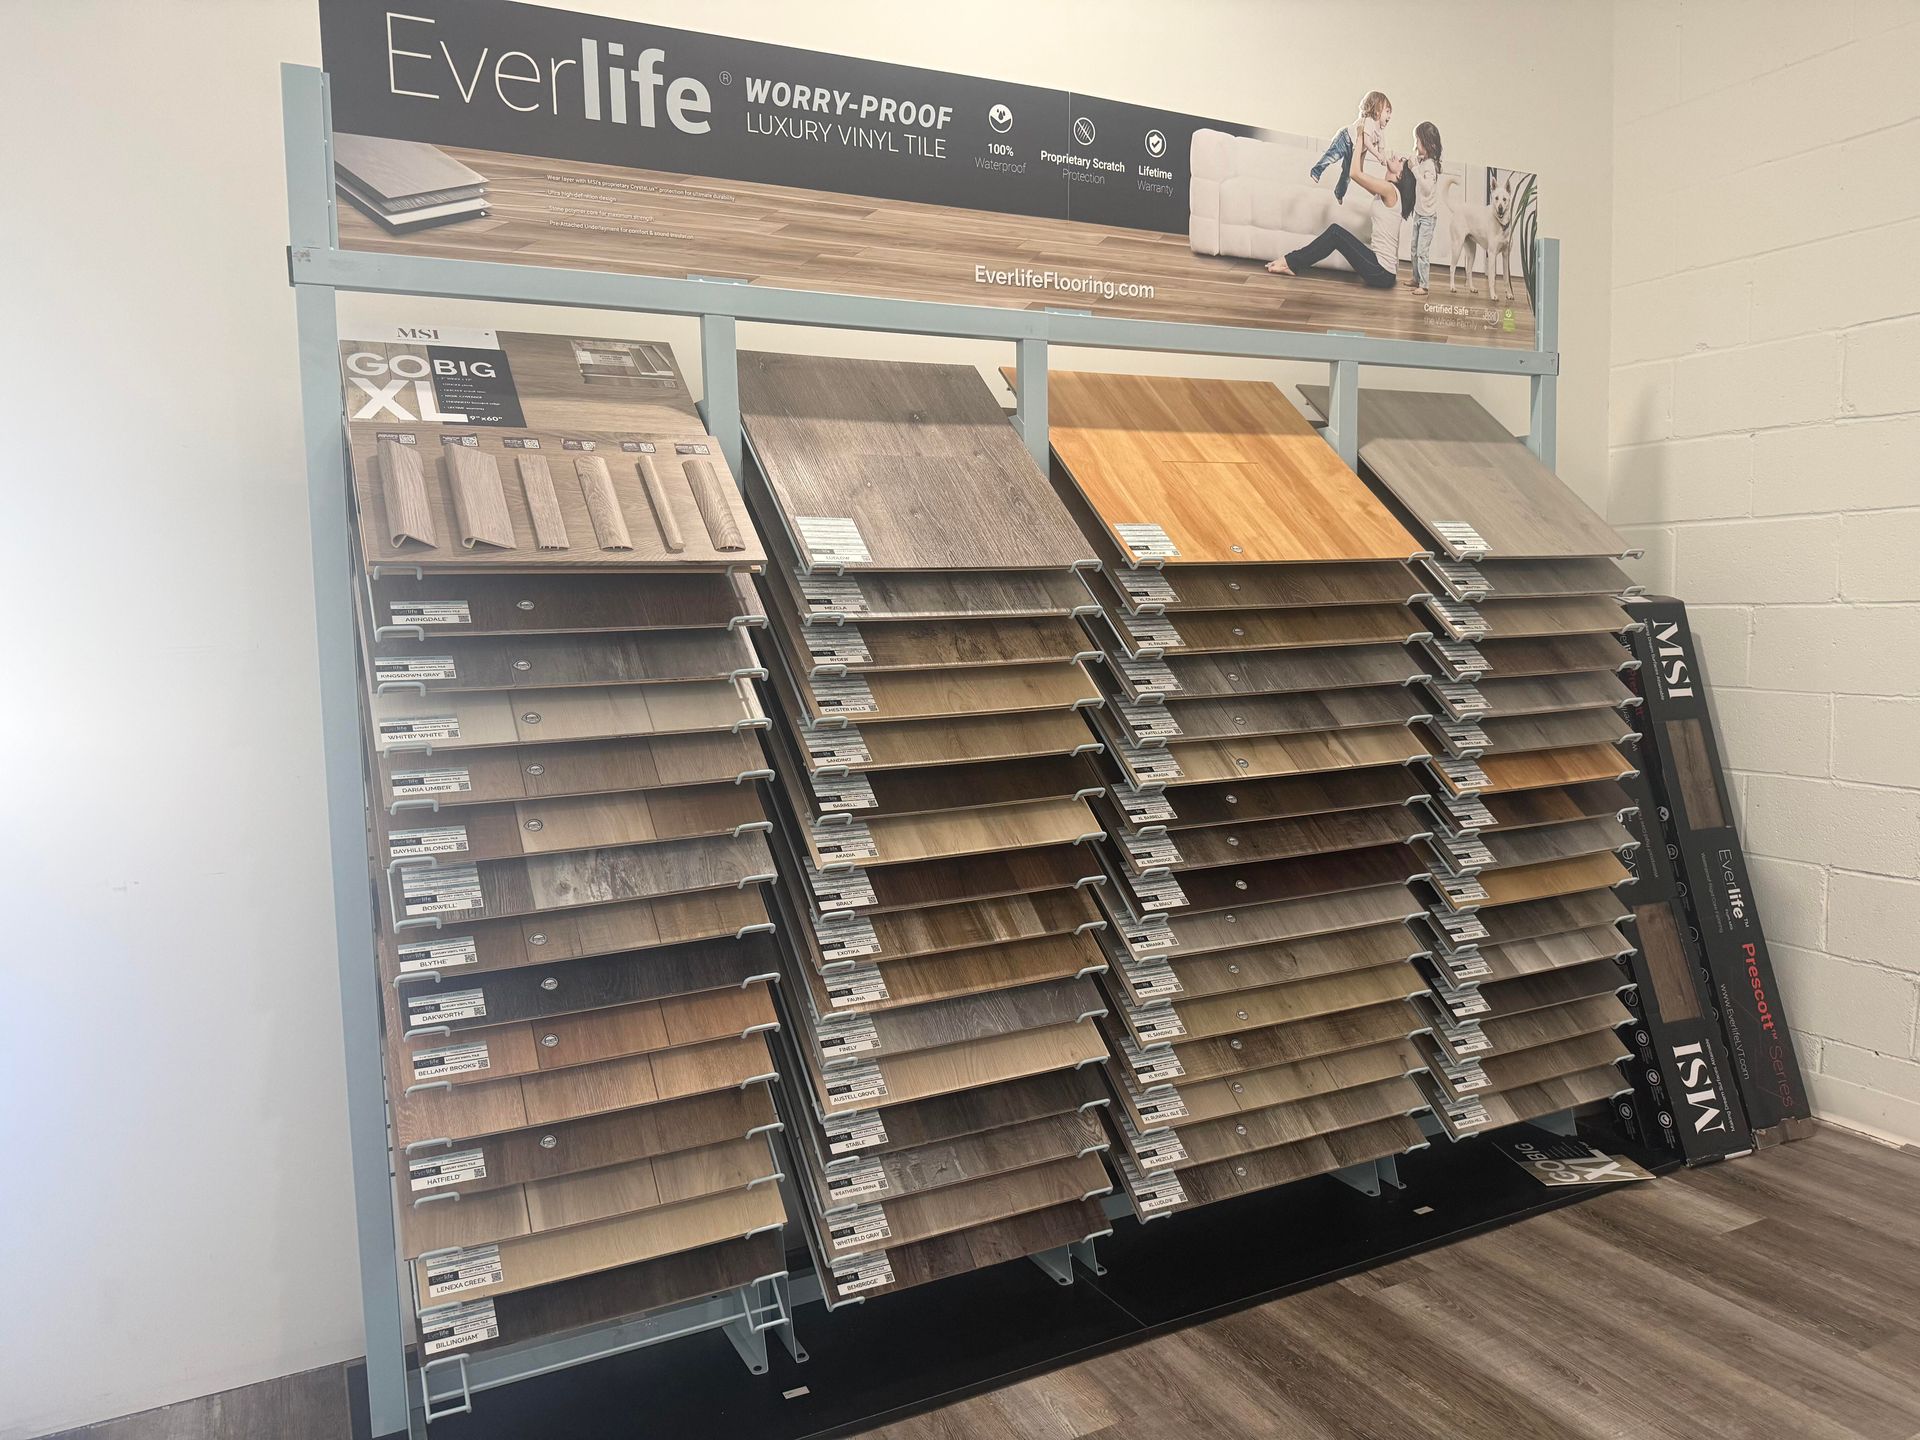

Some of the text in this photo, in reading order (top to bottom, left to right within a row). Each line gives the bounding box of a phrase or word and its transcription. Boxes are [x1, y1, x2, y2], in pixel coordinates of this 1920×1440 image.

[386, 12, 711, 134] Everlife
[745, 76, 953, 130] WORRY-PROOF
[746, 112, 947, 159] LUXURY VINYL TILE
[987, 142, 1014, 157] 100%
[974, 157, 1026, 175] Waterproof
[1040, 150, 1125, 173] Proprietary Scratch
[1062, 168, 1105, 185] Protection
[1138, 165, 1173, 181] Lifetime
[1137, 180, 1174, 196] Warranty
[974, 264, 1155, 299] EverlifeFlooring.com
[1424, 303, 1469, 316] Certified Safe
[397, 327, 440, 340] MSI
[346, 352, 497, 378] GO BIG
[348, 376, 469, 423] XL
[1651, 618, 1694, 700] MSI
[1718, 850, 1744, 918] Everlife
[422, 904, 457, 912] BOSWELL
[420, 960, 448, 968] BLYTHE
[1720, 984, 1750, 1080] www.EverlifeLVT.com
[1742, 942, 1775, 1031] Prescott
[1769, 1044, 1793, 1108] Series
[418, 1062, 476, 1076] BELLAMY BROOKS
[1672, 1040, 1726, 1134] MSI
[834, 1090, 876, 1102] AUSTELL GROVE
[1514, 1142, 1550, 1161] BIG
[426, 1174, 461, 1186] HATFIELD
[836, 1235, 866, 1246] WHITFIELD
[436, 1277, 486, 1294] LENEXA CREEK
[436, 1334, 478, 1350] BILLINGHAM
